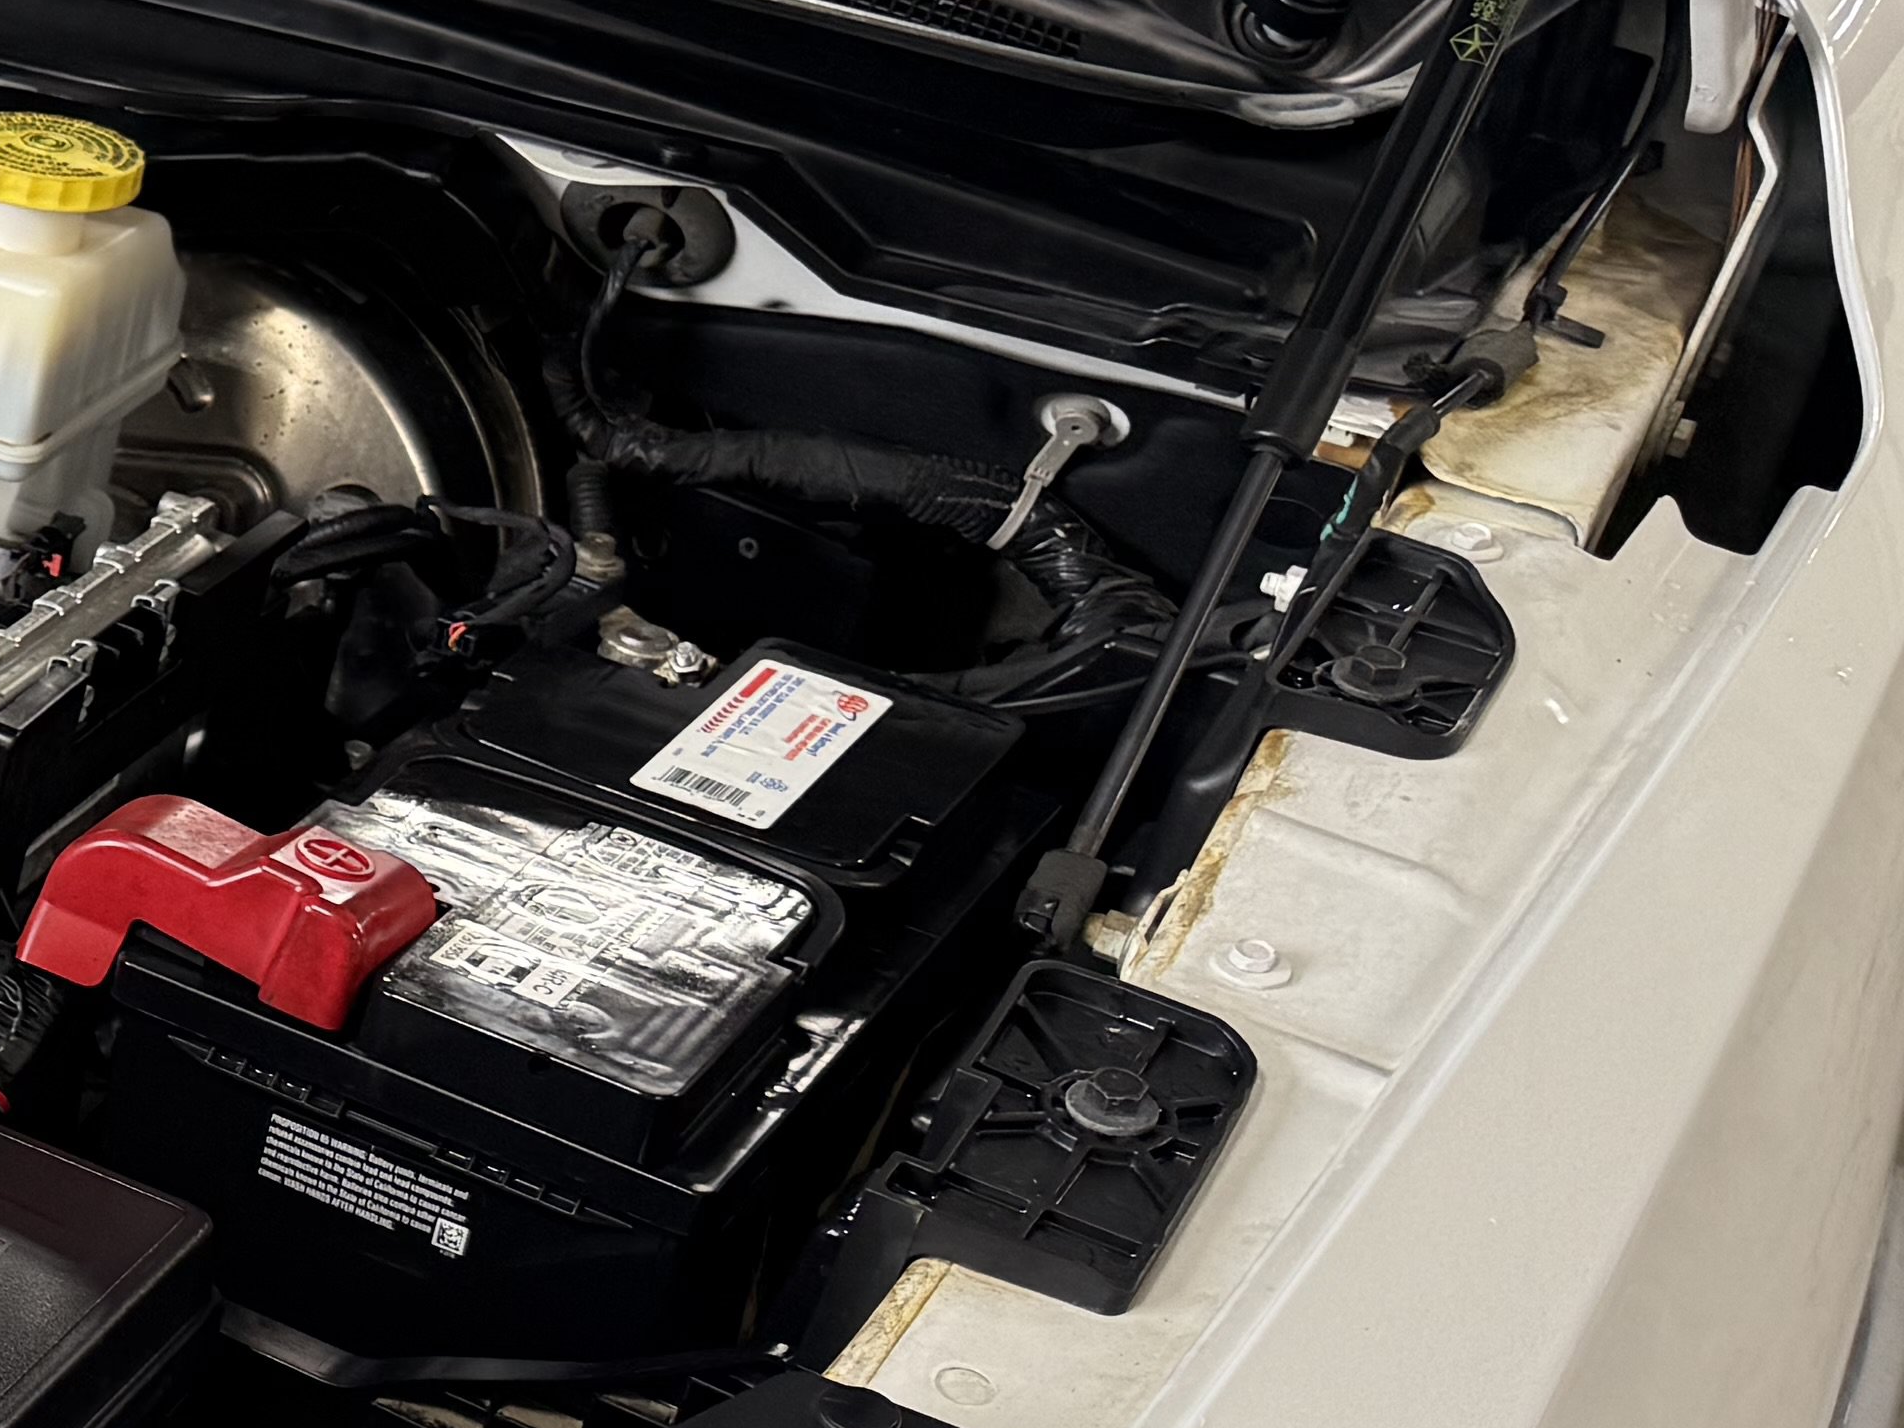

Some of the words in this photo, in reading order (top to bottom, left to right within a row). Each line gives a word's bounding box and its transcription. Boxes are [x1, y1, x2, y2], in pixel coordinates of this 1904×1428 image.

[261, 1156, 295, 1176] chemicals
[296, 1170, 318, 1185] known
[319, 1180, 326, 1188] to
[328, 1183, 339, 1194] the
[340, 1188, 358, 1202] State
[359, 1196, 366, 1205] of
[368, 1200, 401, 1219] California
[403, 1214, 410, 1223] to
[411, 1218, 432, 1232] cause
[264, 1146, 276, 1156] and
[278, 1152, 319, 1174] reproductive
[343, 1178, 373, 1196] Batteries
[374, 1191, 389, 1203] also
[390, 1198, 416, 1214] contain
[417, 1209, 436, 1222] other
[266, 1135, 302, 1155] chemicals
[302, 1150, 325, 1165] known
[326, 1159, 333, 1168] to
[334, 1162, 345, 1173] the
[347, 1168, 365, 1181] State
[367, 1176, 374, 1184] of
[375, 1179, 409, 1199] California
[411, 1194, 418, 1202] to
[419, 1197, 441, 1211] cause
[269, 1124, 293, 1140] related
[295, 1135, 335, 1157] accessories
[336, 1151, 361, 1168] contain
[363, 1163, 378, 1175] lead
[380, 1170, 393, 1181] and
[395, 1175, 410, 1188] lead
[272, 1113, 320, 1139] PROPOSITION
[369, 1153, 394, 1169] Battery
[419, 1173, 453, 1193] terminals
[455, 1187, 469, 1199] and
[284, 1177, 305, 1192] WASH
[306, 1186, 331, 1203] HANDS
[332, 1197, 354, 1212] AFTER
